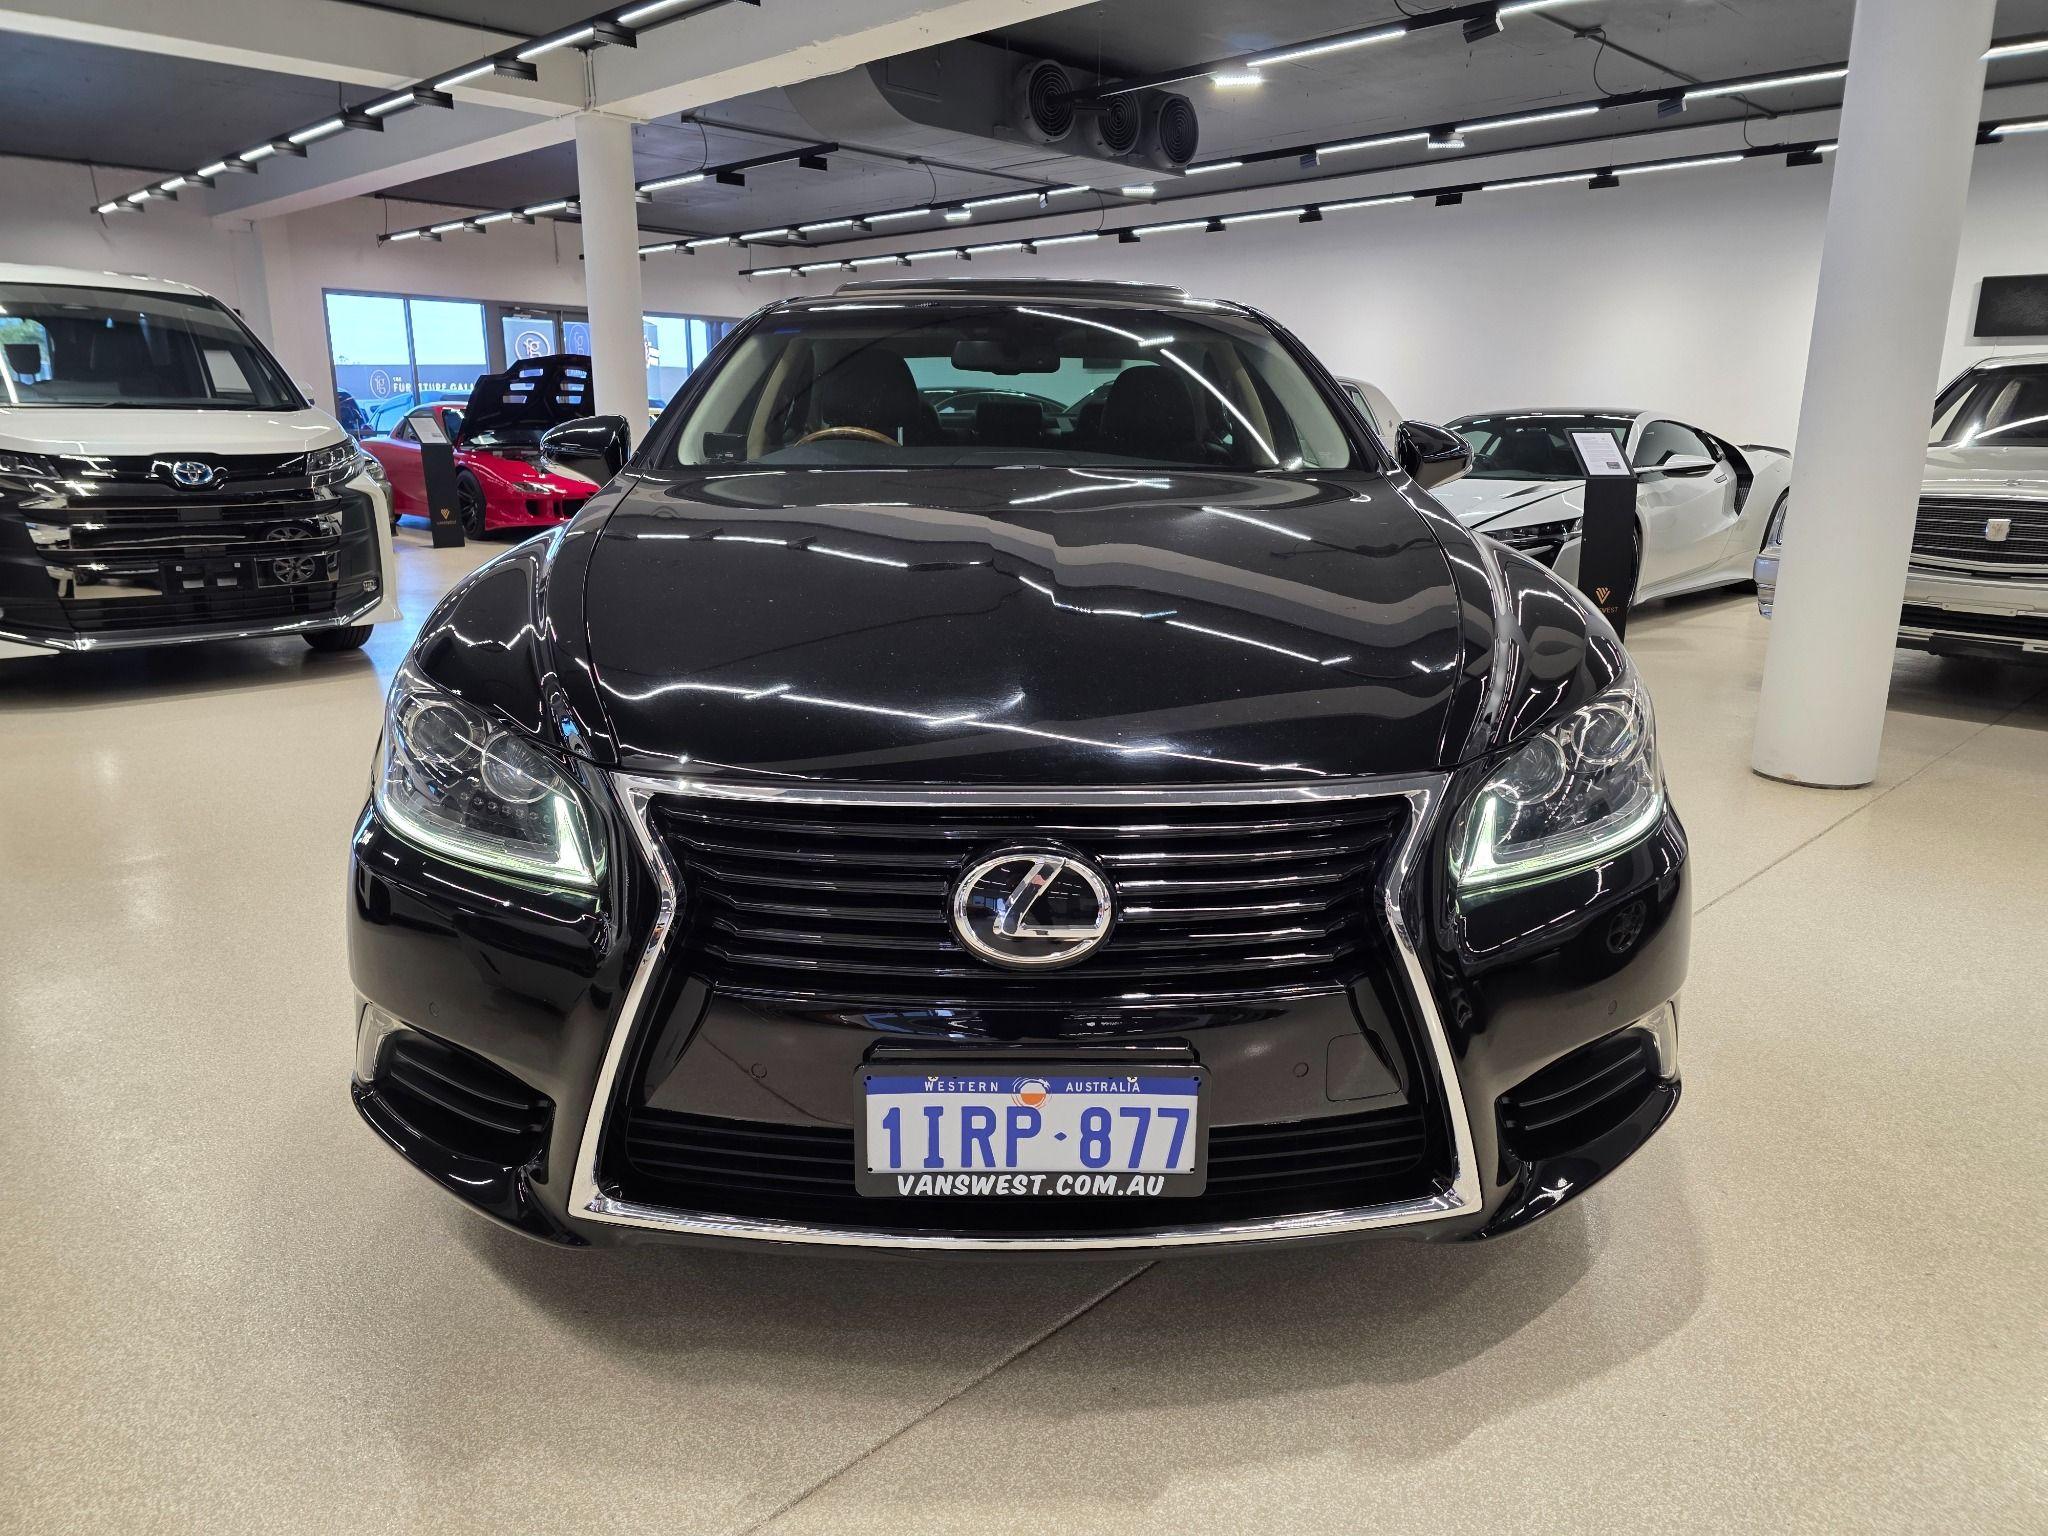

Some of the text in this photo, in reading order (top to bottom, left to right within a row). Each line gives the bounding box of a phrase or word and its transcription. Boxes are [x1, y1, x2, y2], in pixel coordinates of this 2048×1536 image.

[393, 382, 447, 393] FURITURE
[924, 1080, 1141, 1093] WESTERN AUSTRALIA
[1080, 1106, 1190, 1169] 877
[897, 1174, 1165, 1196] VANSWEST.COM.AU
